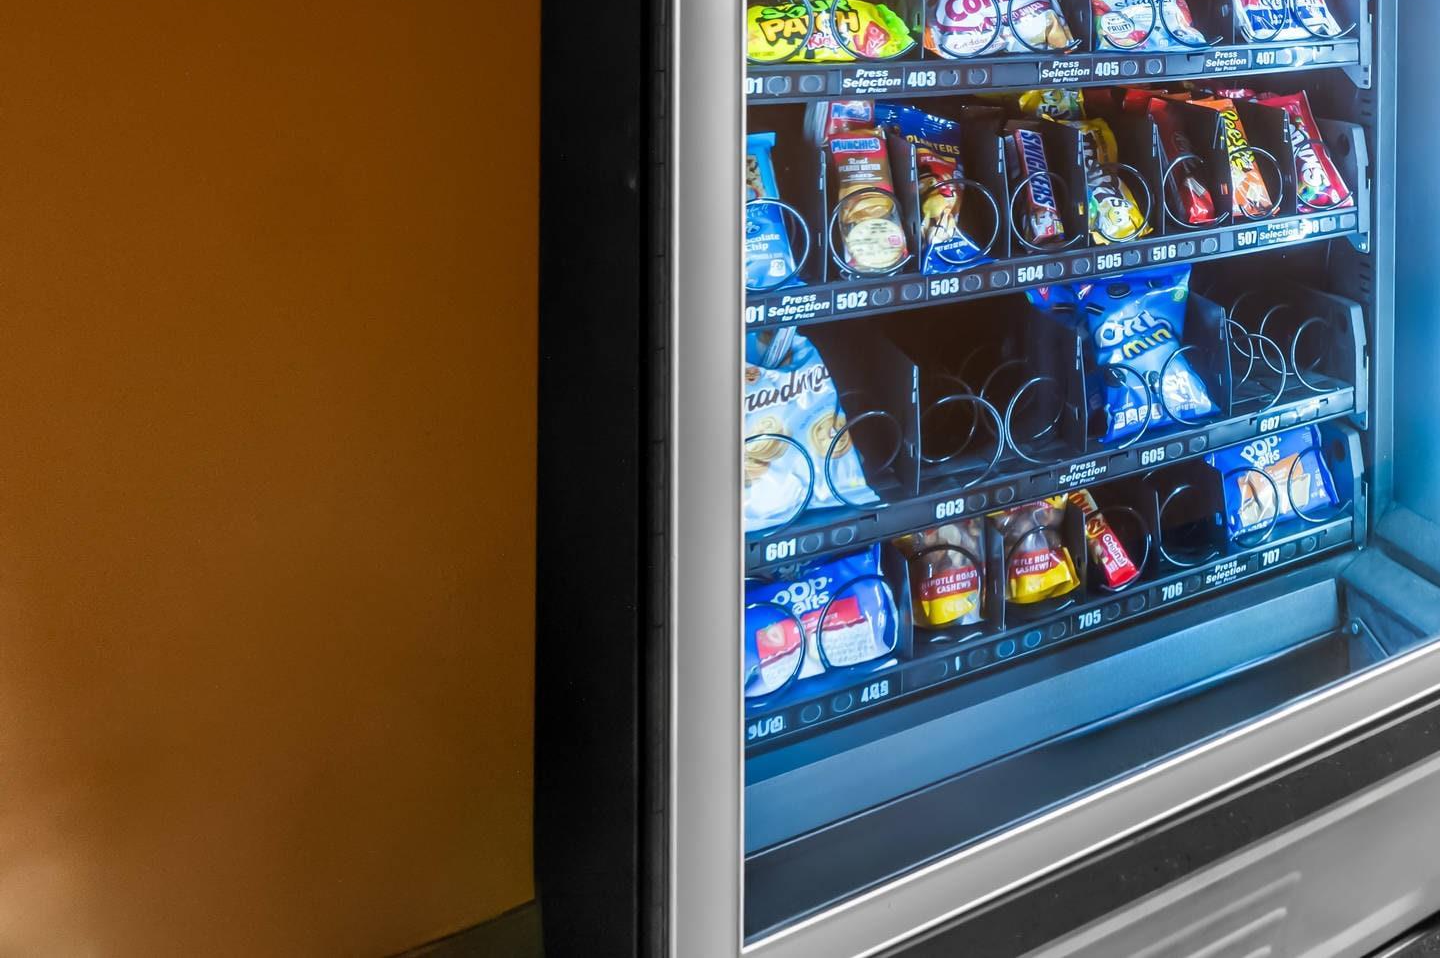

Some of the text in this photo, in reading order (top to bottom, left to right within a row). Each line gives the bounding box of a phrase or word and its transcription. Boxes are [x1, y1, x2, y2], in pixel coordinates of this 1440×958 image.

[1206, 57, 1247, 67] Selection
[1214, 51, 1237, 59] Press
[1256, 51, 1275, 65] 407
[1053, 60, 1079, 69] Press
[1095, 62, 1119, 76] 405
[856, 69, 888, 78] Press
[908, 71, 936, 86] 403
[1041, 67, 1090, 78] Selection
[746, 77, 763, 93] 01
[843, 77, 901, 89] Selection
[831, 138, 880, 152] MUNCHIES
[1021, 130, 1055, 209] SNICKERS
[1268, 222, 1289, 230] Press
[1238, 231, 1257, 246] 507
[1260, 229, 1298, 239] Selection
[1098, 253, 1122, 269] 505
[1017, 267, 1044, 283] 504
[931, 278, 959, 296] 503
[782, 293, 816, 305] Press
[837, 291, 867, 310] 502
[746, 305, 765, 322] 01
[768, 299, 830, 317] Selection
[1123, 329, 1172, 358] min
[1260, 418, 1280, 432] 607
[1141, 448, 1165, 465] 605
[1070, 460, 1096, 472] Press
[1059, 466, 1106, 484] Selection
[936, 498, 964, 519] 603
[766, 539, 796, 560] 601
[1103, 534, 1127, 566] Original
[1262, 549, 1280, 565] 707
[1215, 560, 1237, 573] Press
[1206, 565, 1246, 584] Selection
[936, 581, 971, 593] CASHEWS
[1079, 610, 1101, 630] 705
